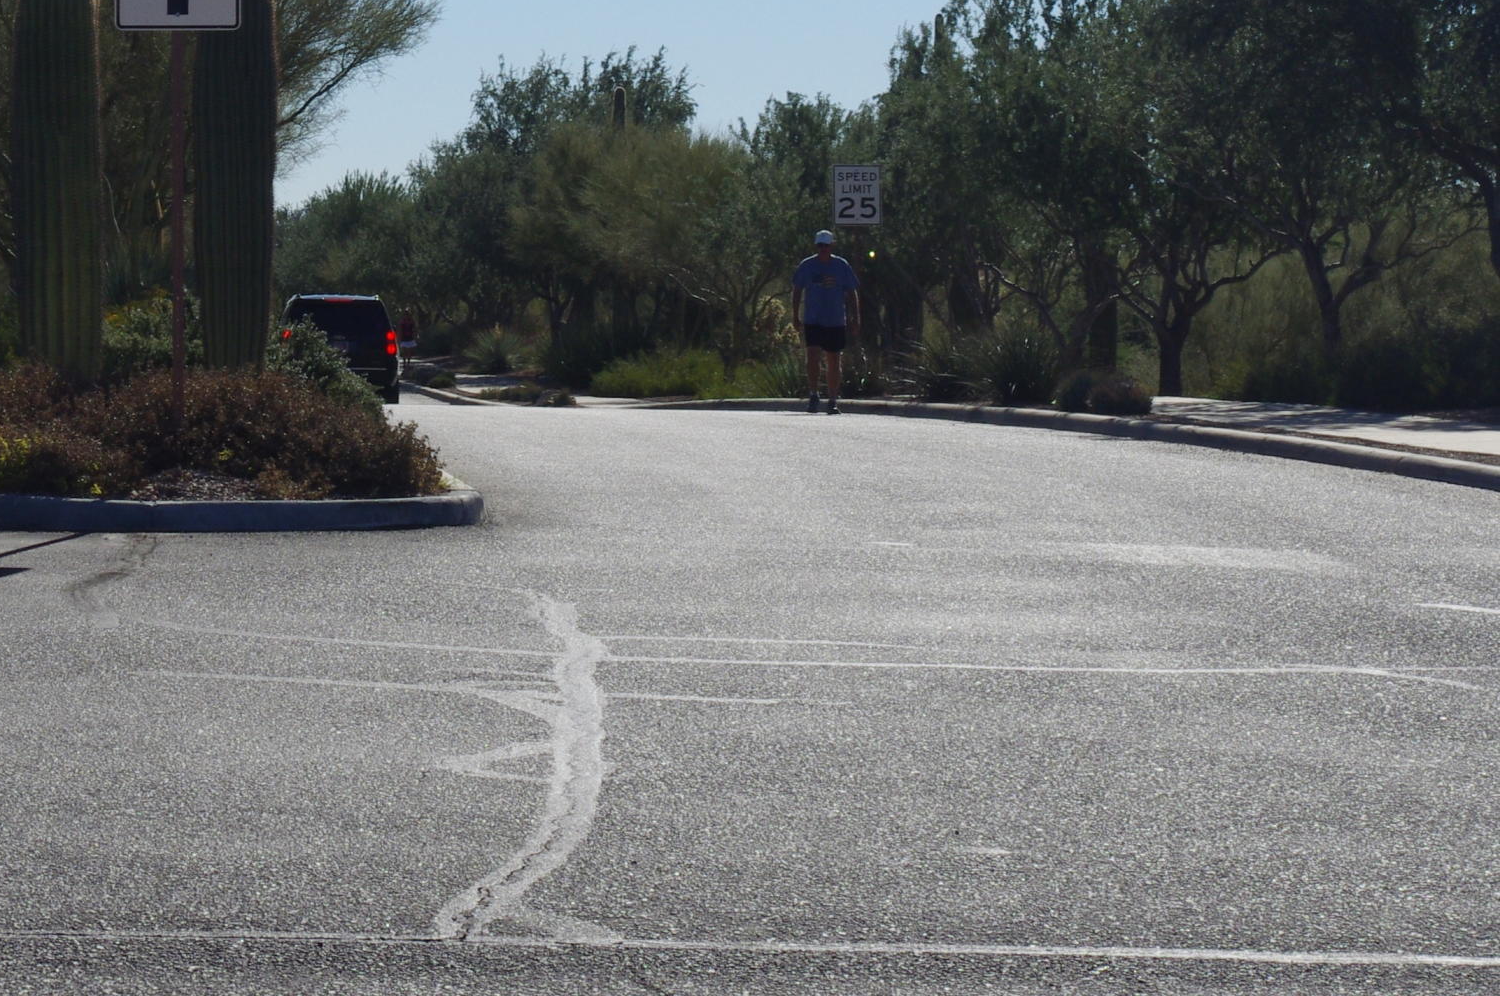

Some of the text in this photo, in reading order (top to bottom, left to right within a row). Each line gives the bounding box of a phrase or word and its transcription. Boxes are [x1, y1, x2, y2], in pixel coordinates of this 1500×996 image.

[837, 172, 877, 181] SPEED
[841, 185, 873, 194] LIMIT
[838, 197, 877, 219] 25
